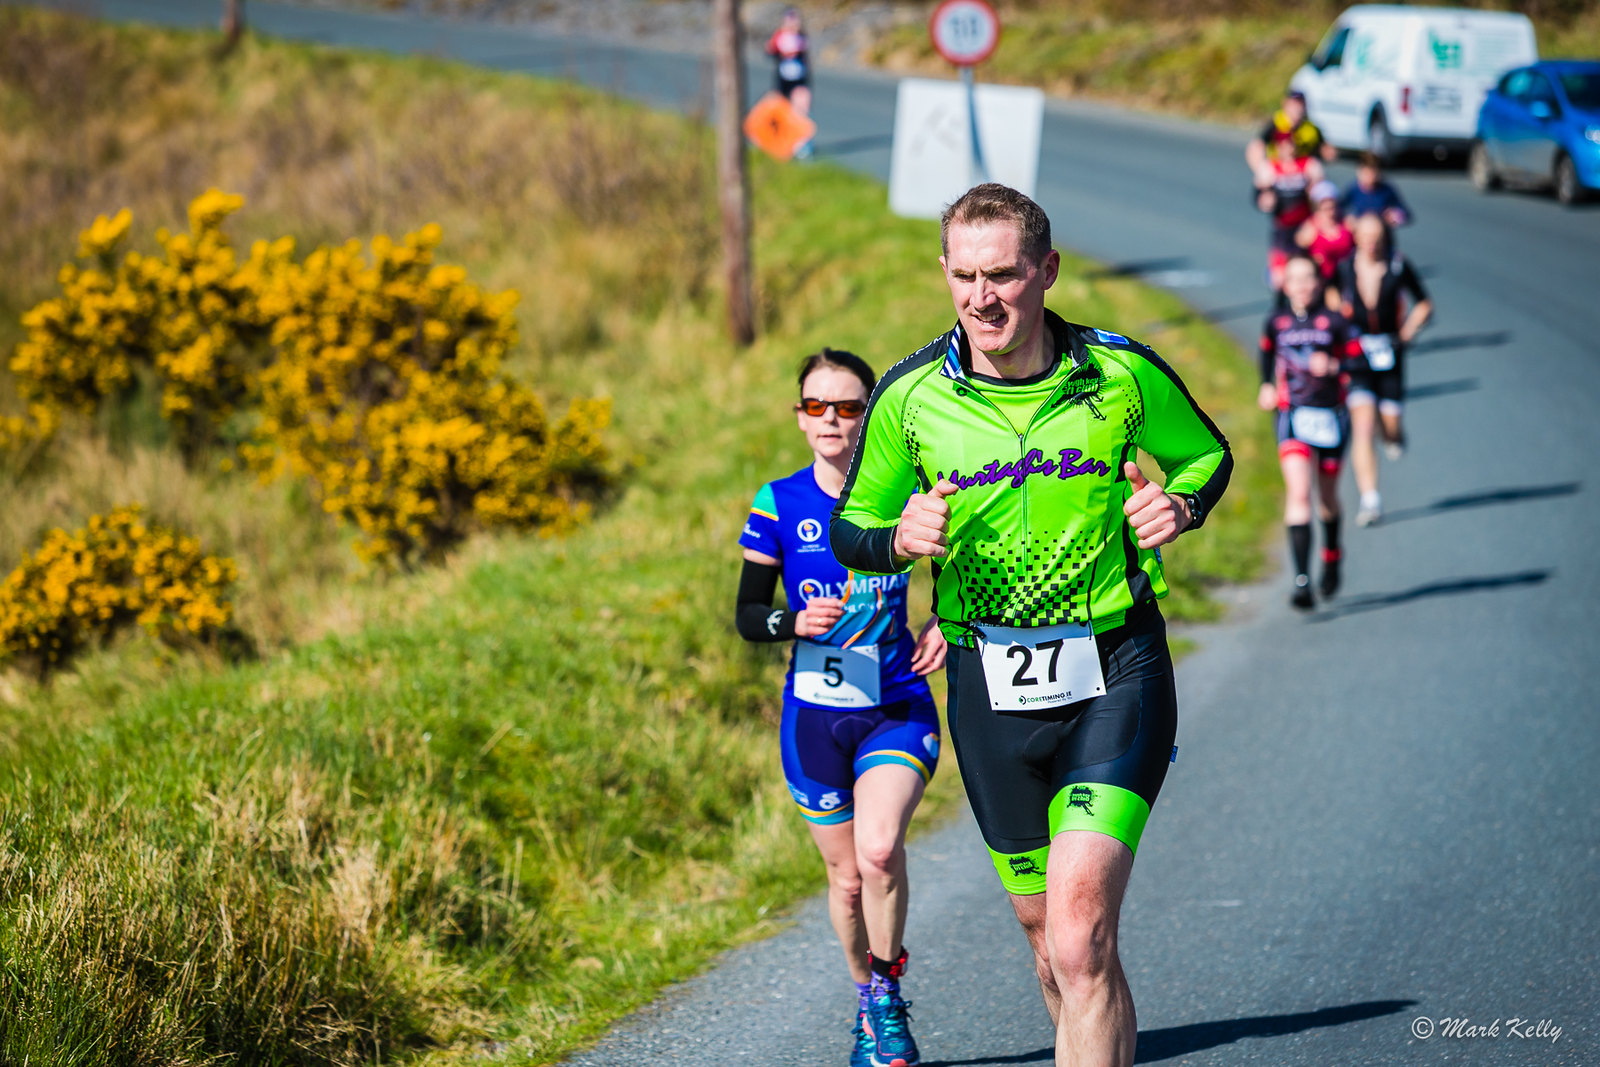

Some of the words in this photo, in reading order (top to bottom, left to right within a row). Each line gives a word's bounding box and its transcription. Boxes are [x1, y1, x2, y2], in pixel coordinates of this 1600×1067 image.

[1057, 448, 1112, 480] Bar
[823, 656, 844, 687] 5
[1006, 638, 1064, 687] 27
